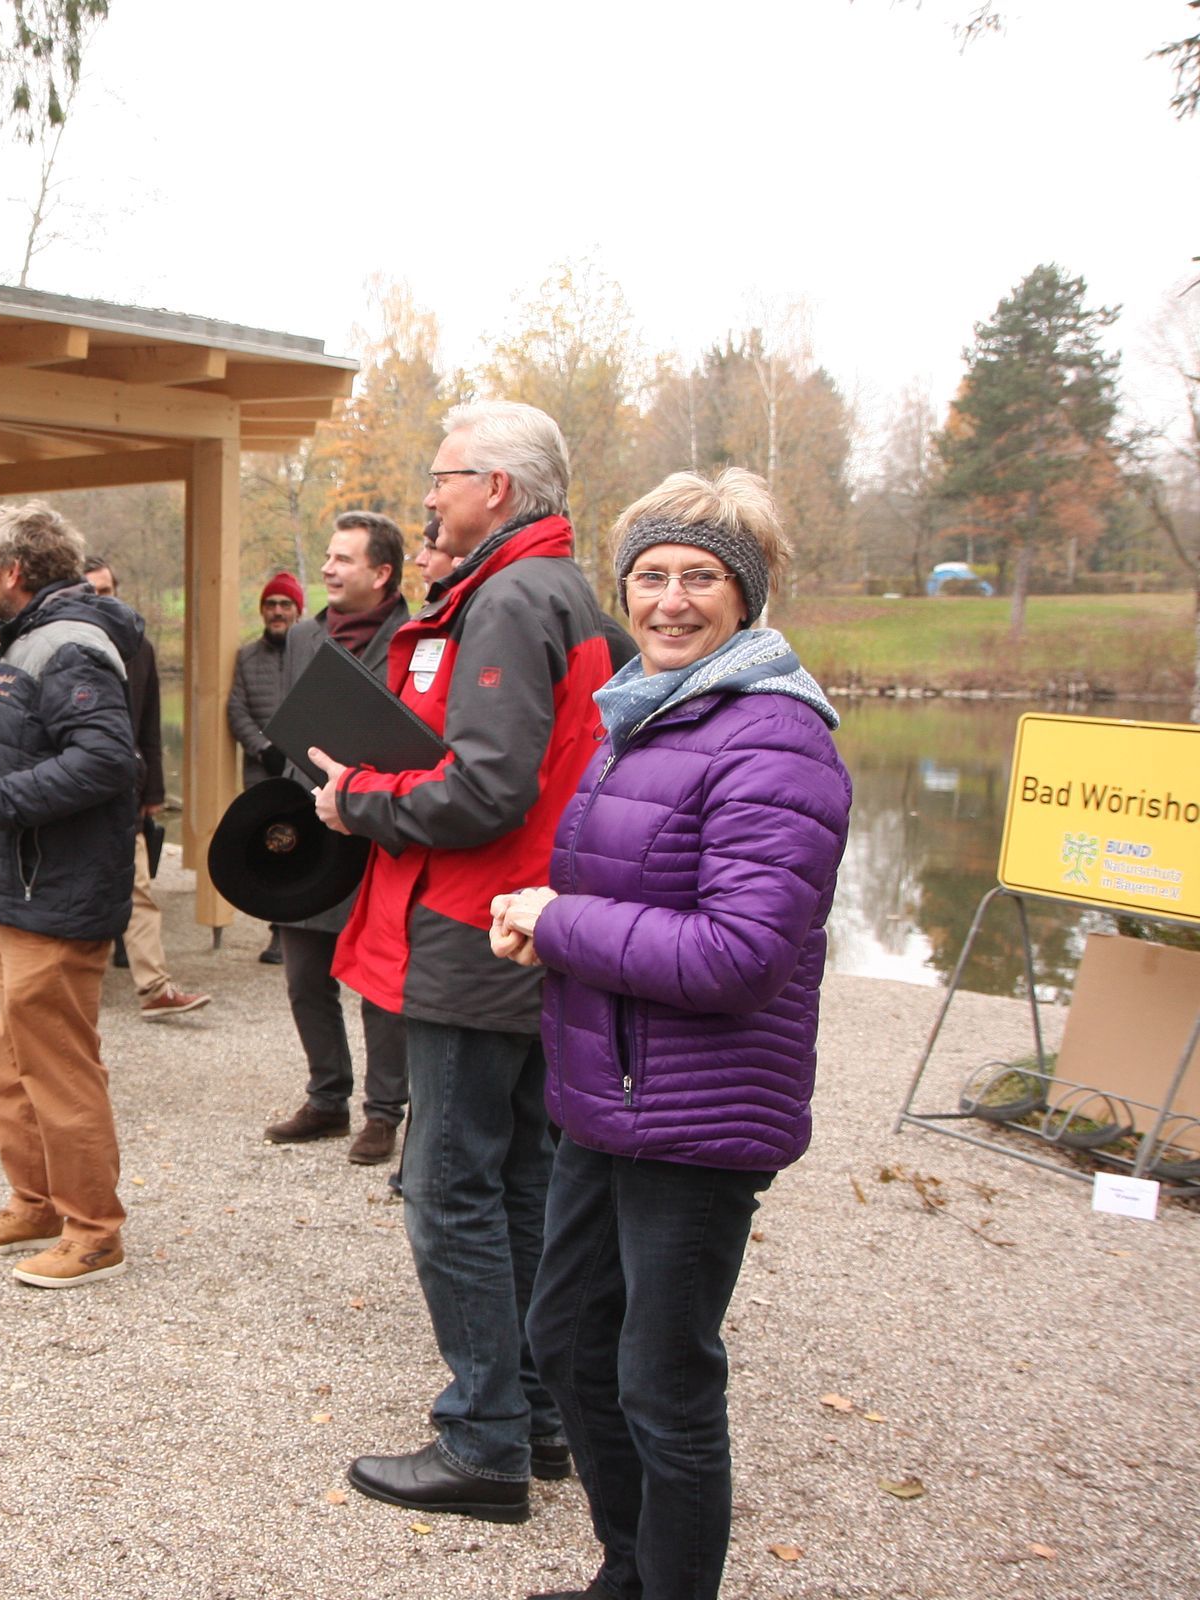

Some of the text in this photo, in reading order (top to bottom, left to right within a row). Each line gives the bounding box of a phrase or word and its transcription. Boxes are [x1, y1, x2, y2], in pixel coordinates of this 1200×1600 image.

[1021, 776, 1200, 823] Bad Wörisho
[1105, 840, 1152, 858] BUND
